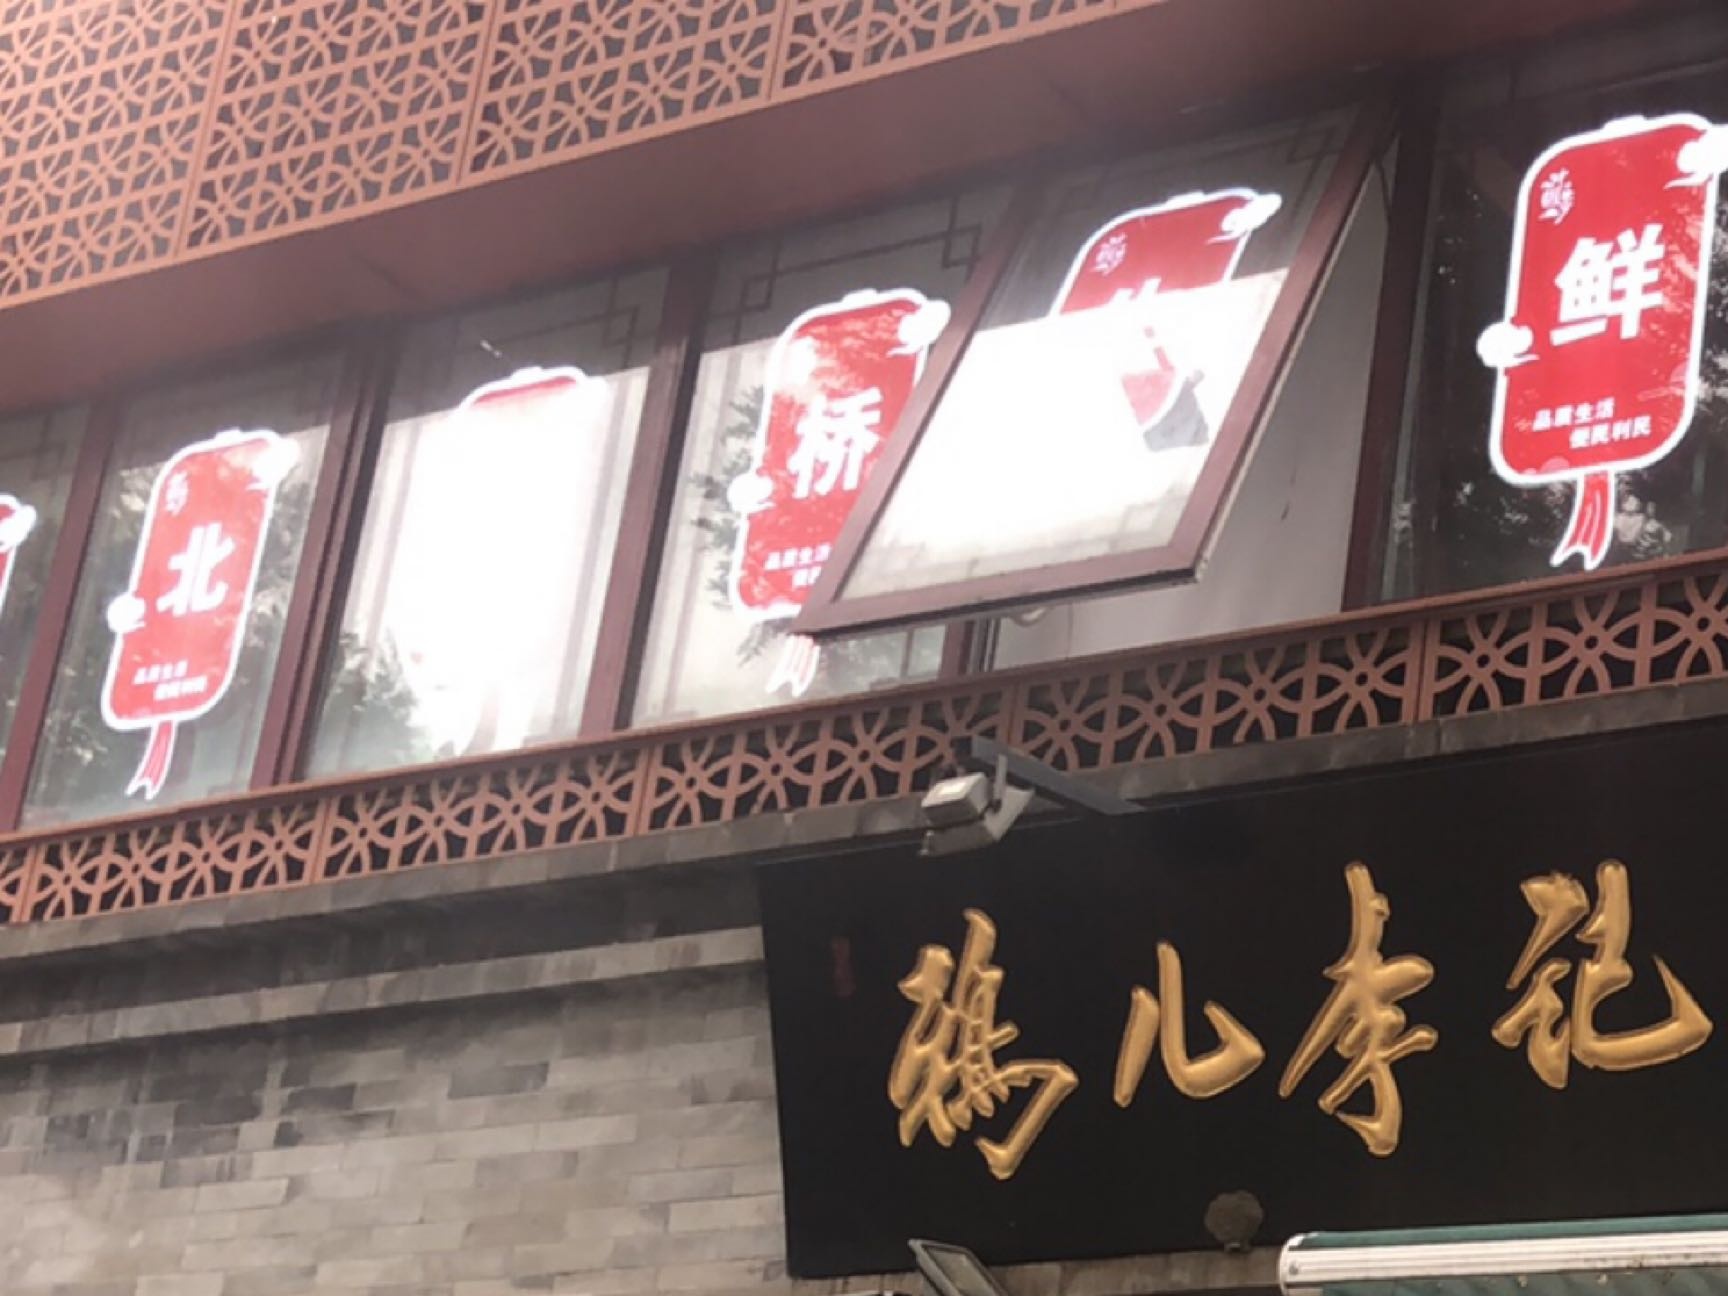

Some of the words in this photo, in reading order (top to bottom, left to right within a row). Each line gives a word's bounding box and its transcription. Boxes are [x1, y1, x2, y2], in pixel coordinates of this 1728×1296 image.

[1550, 223, 1666, 346] 鲜
[789, 387, 882, 499] 桥
[156, 522, 235, 616] 北
